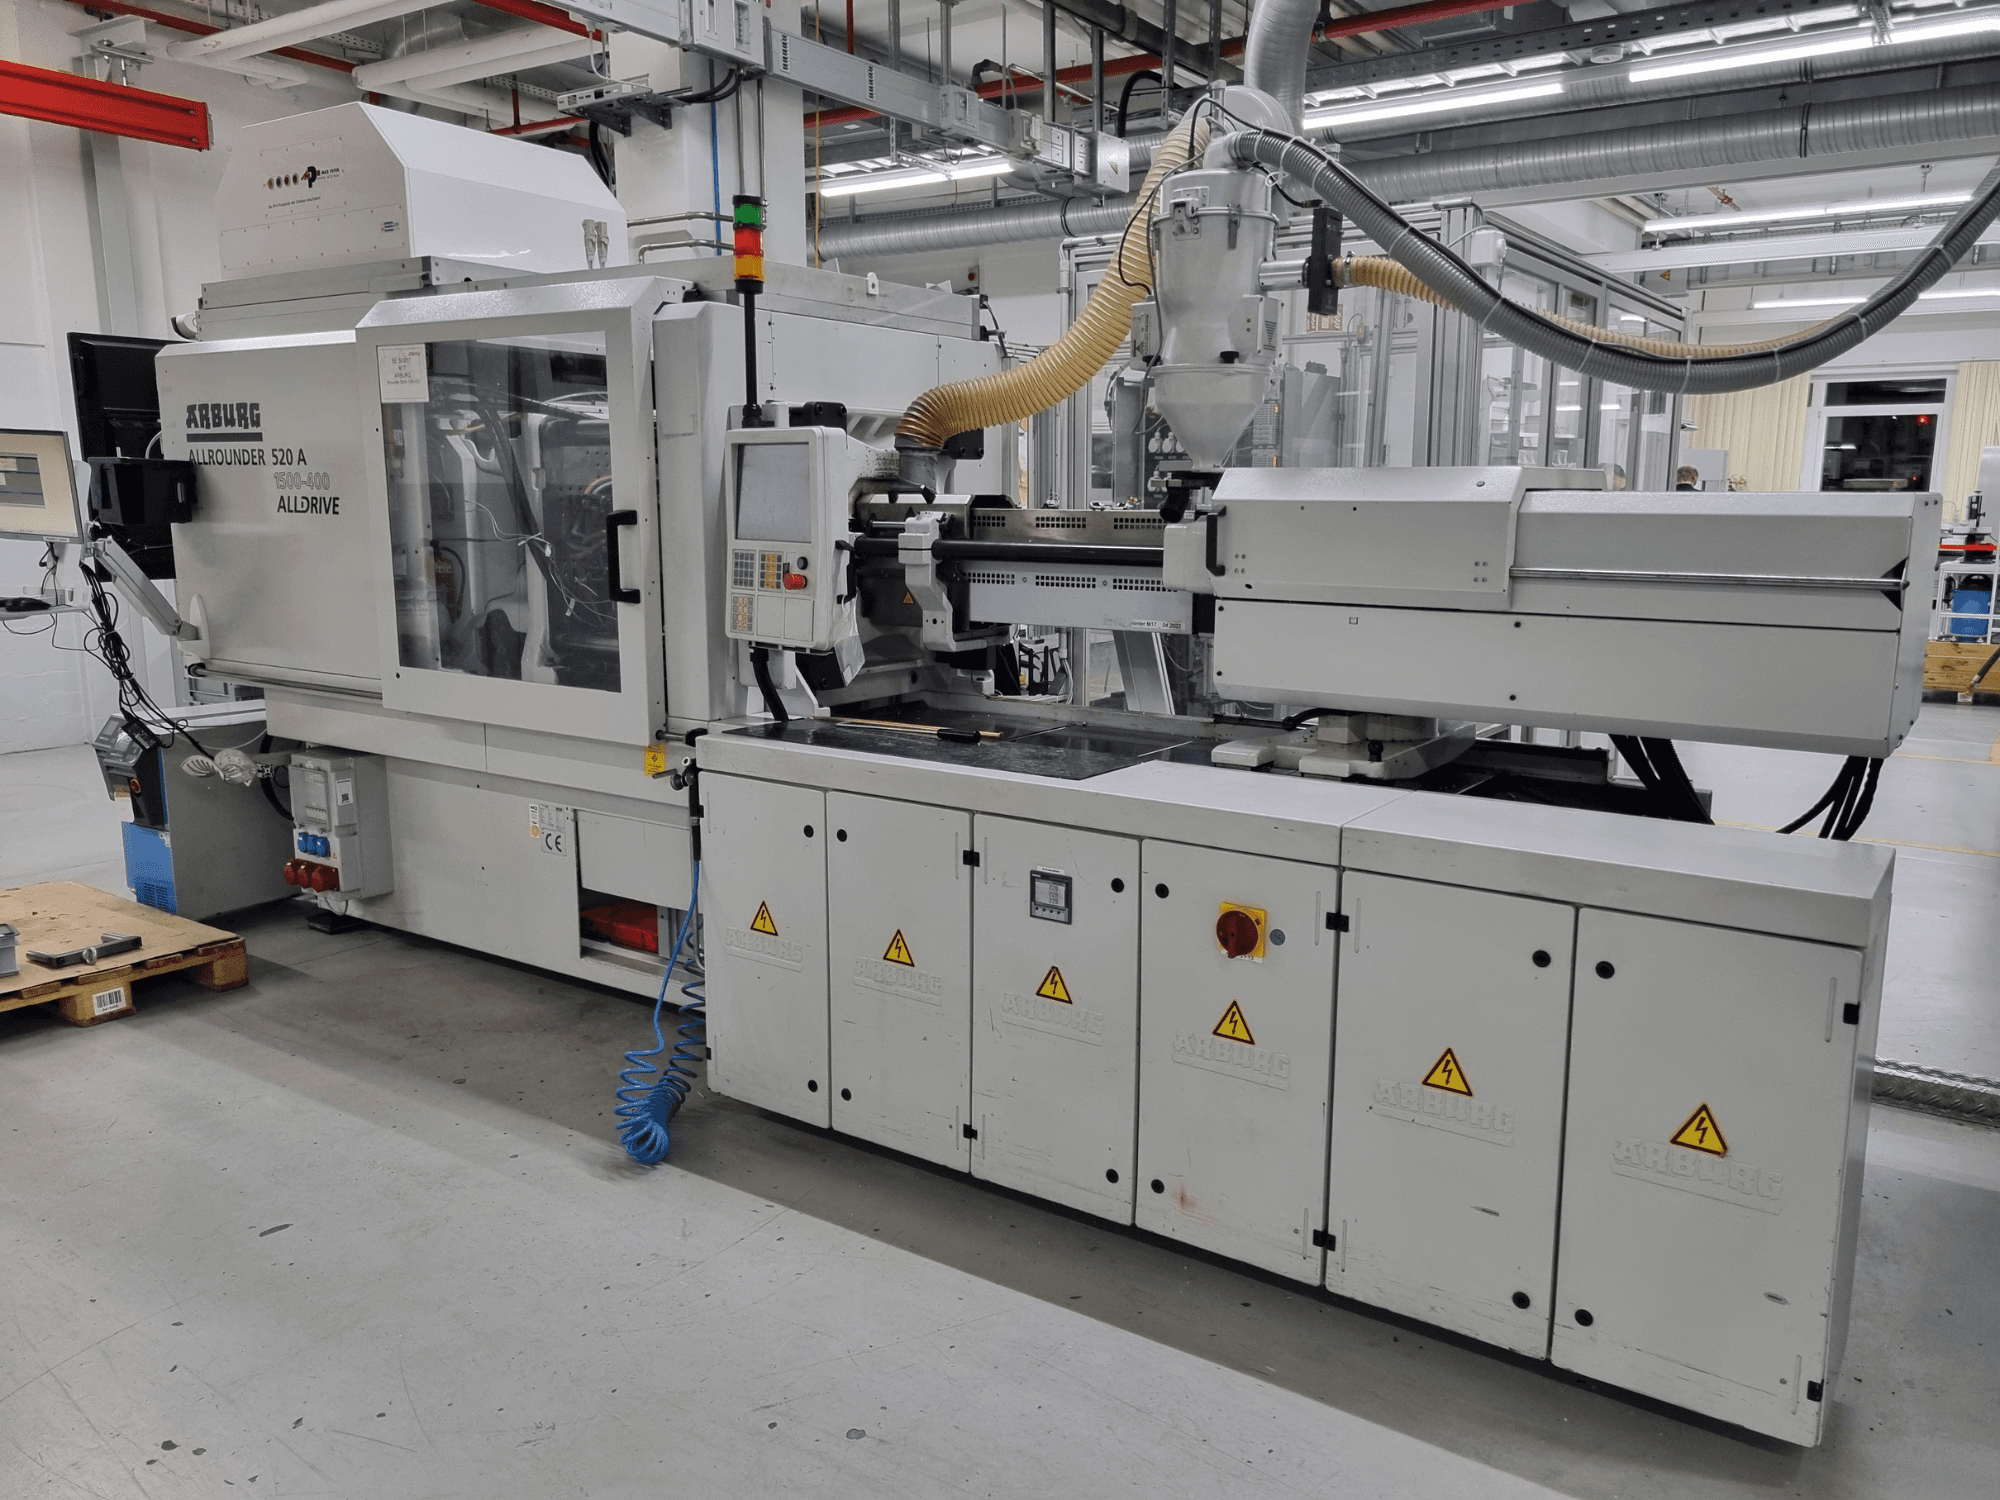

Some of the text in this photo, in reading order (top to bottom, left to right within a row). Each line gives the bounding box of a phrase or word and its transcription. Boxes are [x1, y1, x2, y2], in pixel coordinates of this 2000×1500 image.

[186, 402, 261, 429] ARBURG
[189, 448, 307, 466] ALLROUNDER 520 A
[274, 472, 330, 490] 1500-400
[725, 927, 802, 963] ARBURG
[854, 956, 941, 995] ARBURG
[1001, 993, 1102, 1035] ARBURG
[1172, 1031, 1291, 1079] ARBURG
[1373, 1078, 1514, 1133] ARBURG
[1612, 1136, 1783, 1200] ARBURG
